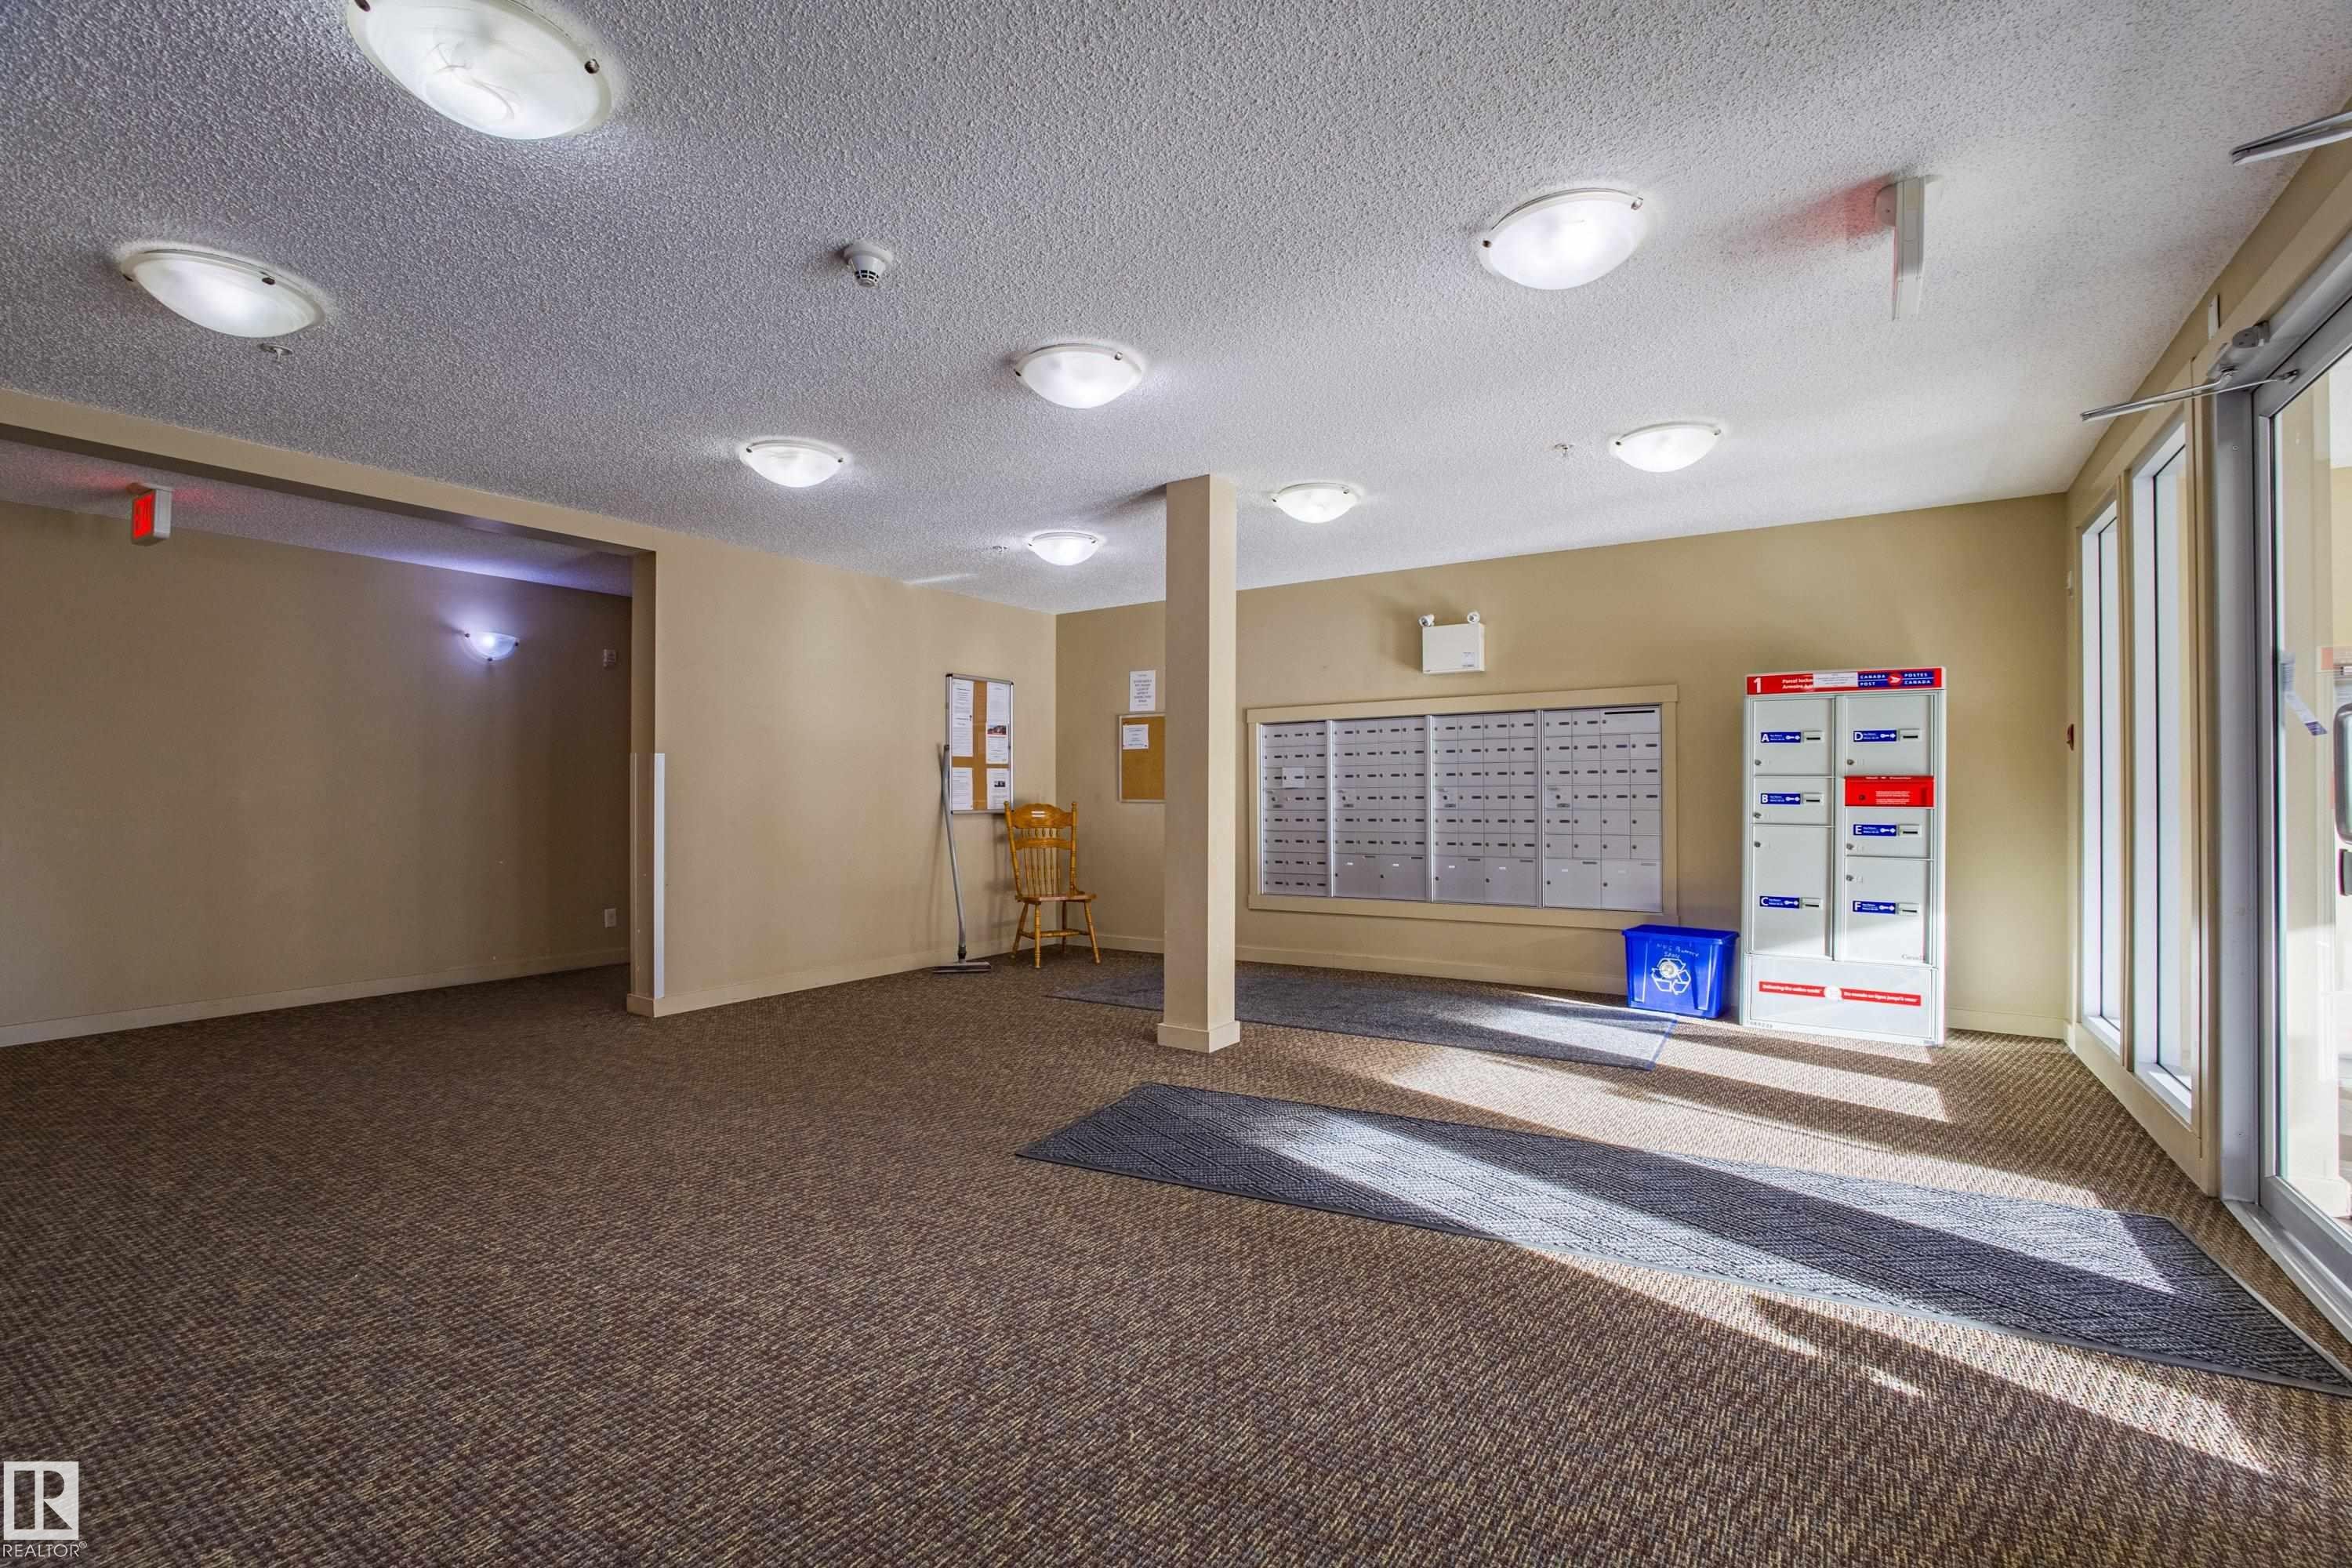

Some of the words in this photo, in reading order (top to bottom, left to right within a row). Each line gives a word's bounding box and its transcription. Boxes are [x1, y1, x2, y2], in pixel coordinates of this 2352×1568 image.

[1754, 677, 1762, 693] 1
[1761, 733, 1769, 742] A
[1854, 731, 1864, 741] D
[1762, 794, 1769, 803] B
[1856, 825, 1862, 834] E
[1761, 897, 1769, 906] C
[1855, 902, 1861, 910] F
